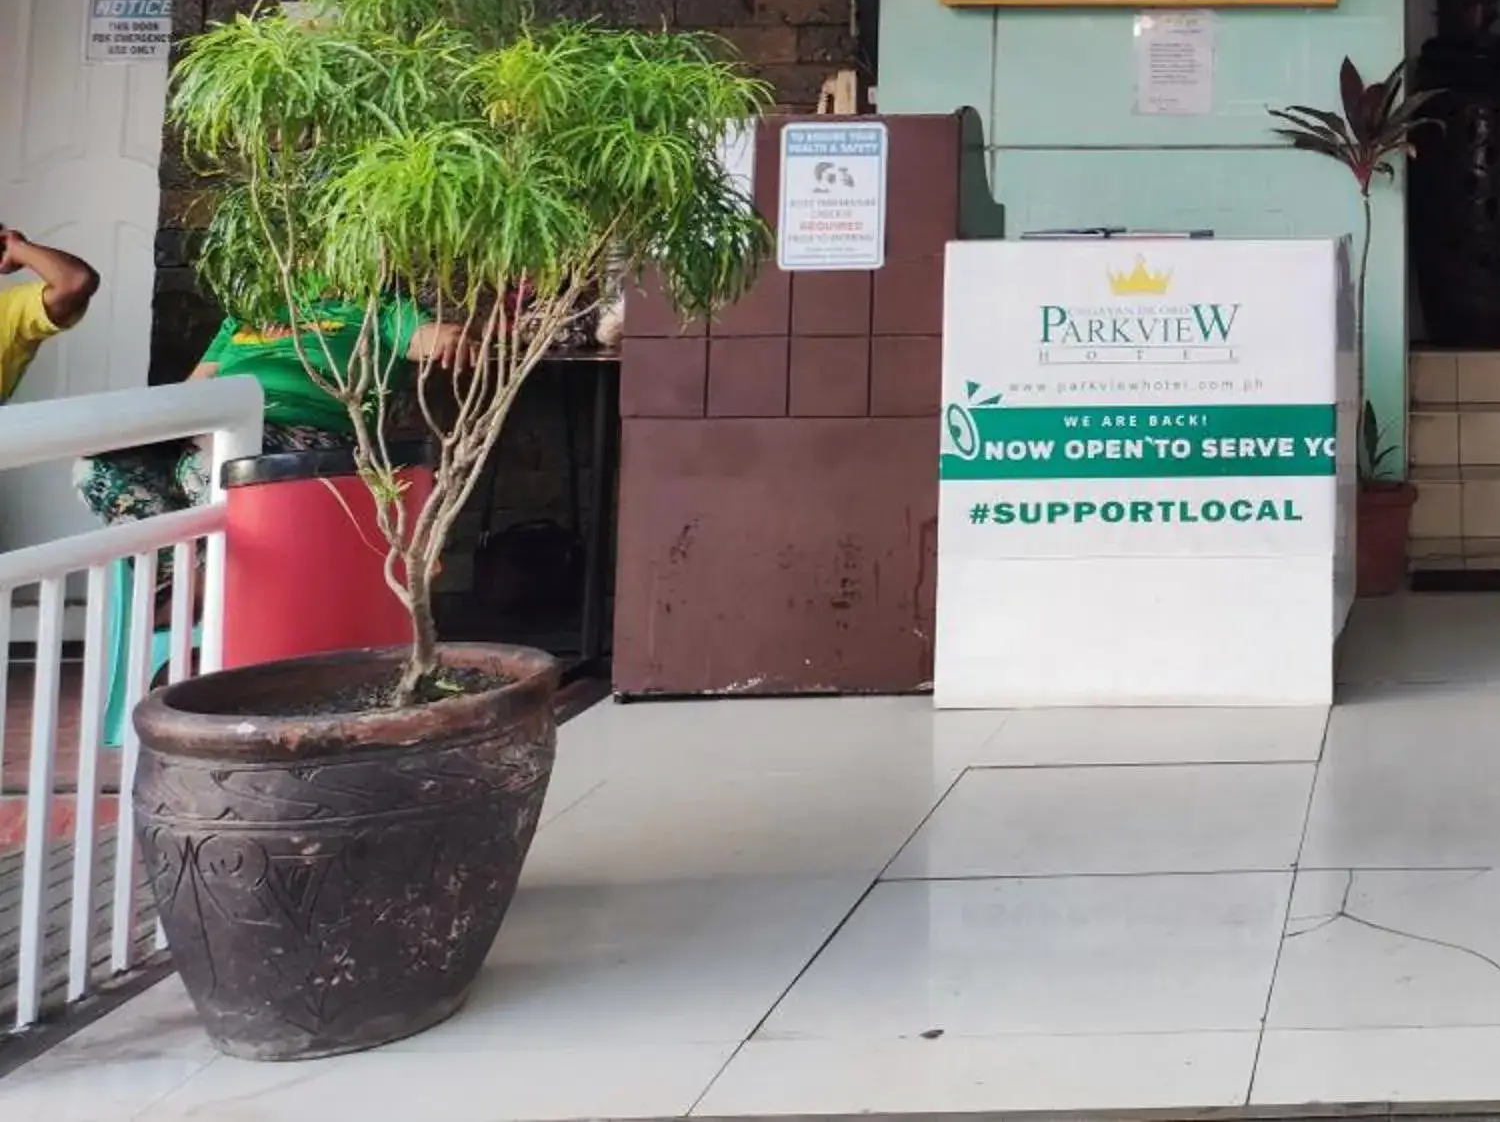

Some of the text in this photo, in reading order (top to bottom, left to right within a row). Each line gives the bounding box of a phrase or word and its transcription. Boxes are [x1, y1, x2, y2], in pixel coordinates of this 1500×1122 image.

[95, 0, 177, 15] NOTICE
[1040, 304, 1241, 344] PARKVIEW
[1064, 414, 1208, 428] WE ARE BACK!
[985, 440, 1055, 462] NOW
[1065, 439, 1144, 460] OPEN
[1154, 438, 1191, 459] TO
[1202, 437, 1295, 459] SERVE
[970, 499, 1303, 525] #SUPPORTLOCAL
